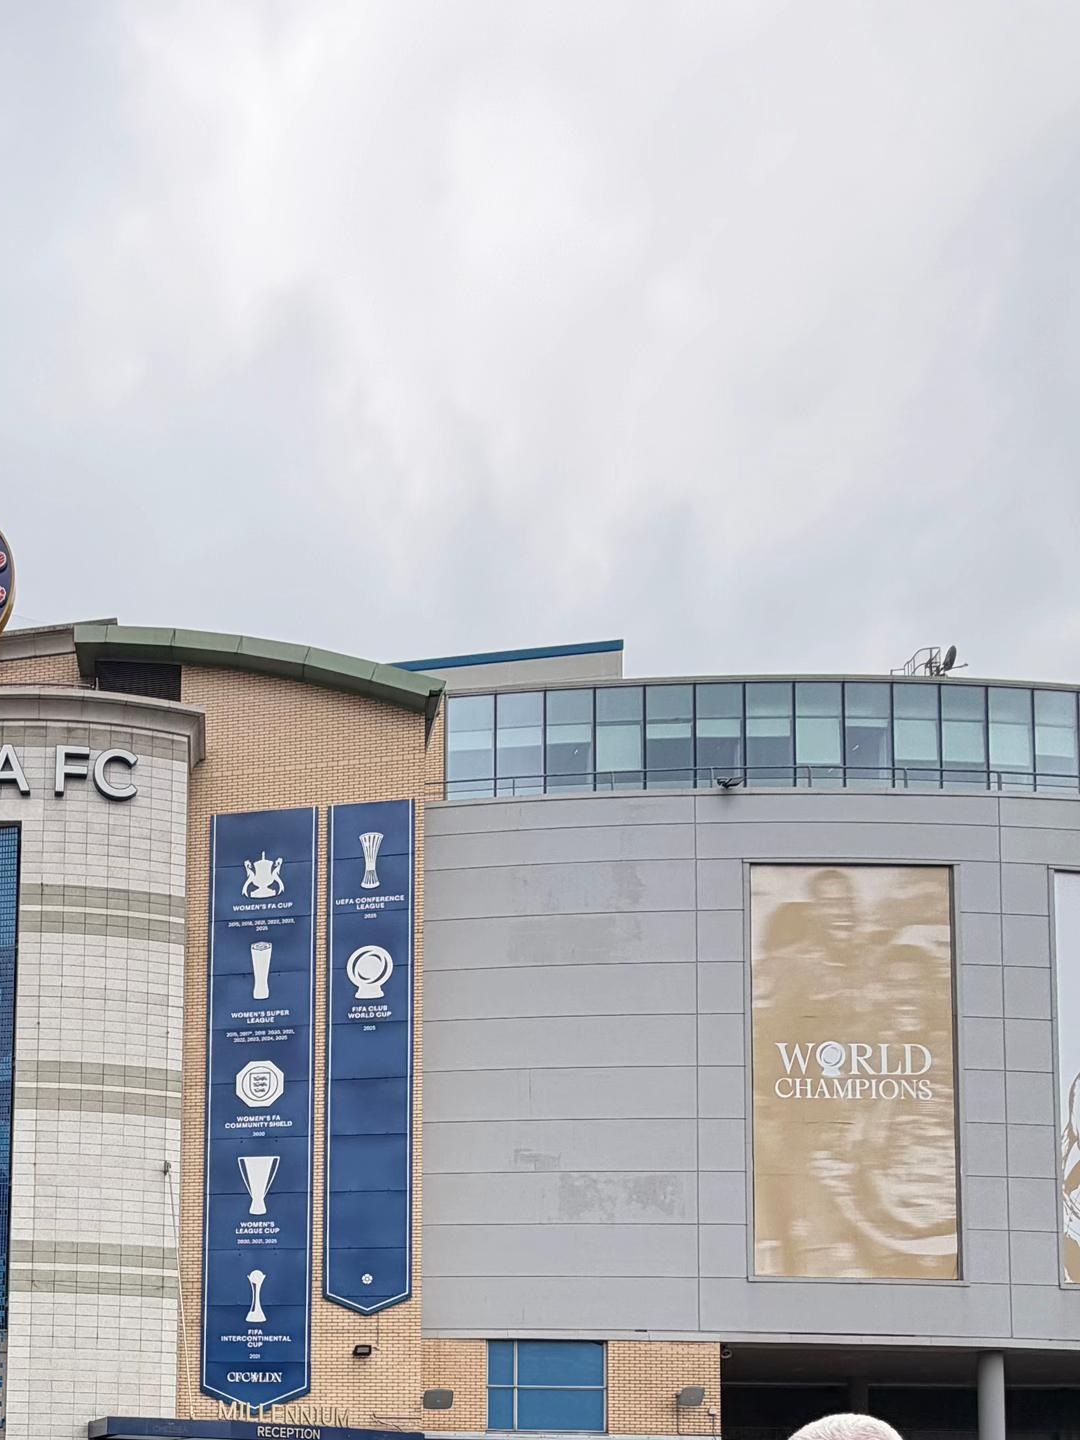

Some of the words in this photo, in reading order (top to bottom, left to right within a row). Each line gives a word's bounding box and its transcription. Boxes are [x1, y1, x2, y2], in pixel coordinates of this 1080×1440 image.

[54, 744, 138, 801] FC
[355, 895, 405, 904] CONFERENCE
[775, 1040, 932, 1076] WORLD
[775, 1077, 933, 1100] CHAMPIONS
[227, 1371, 251, 1382] CFC
[259, 1371, 283, 1383] LDN
[218, 1400, 352, 1428] MILLENNIUM
[257, 1426, 320, 1440] RECEPTION
